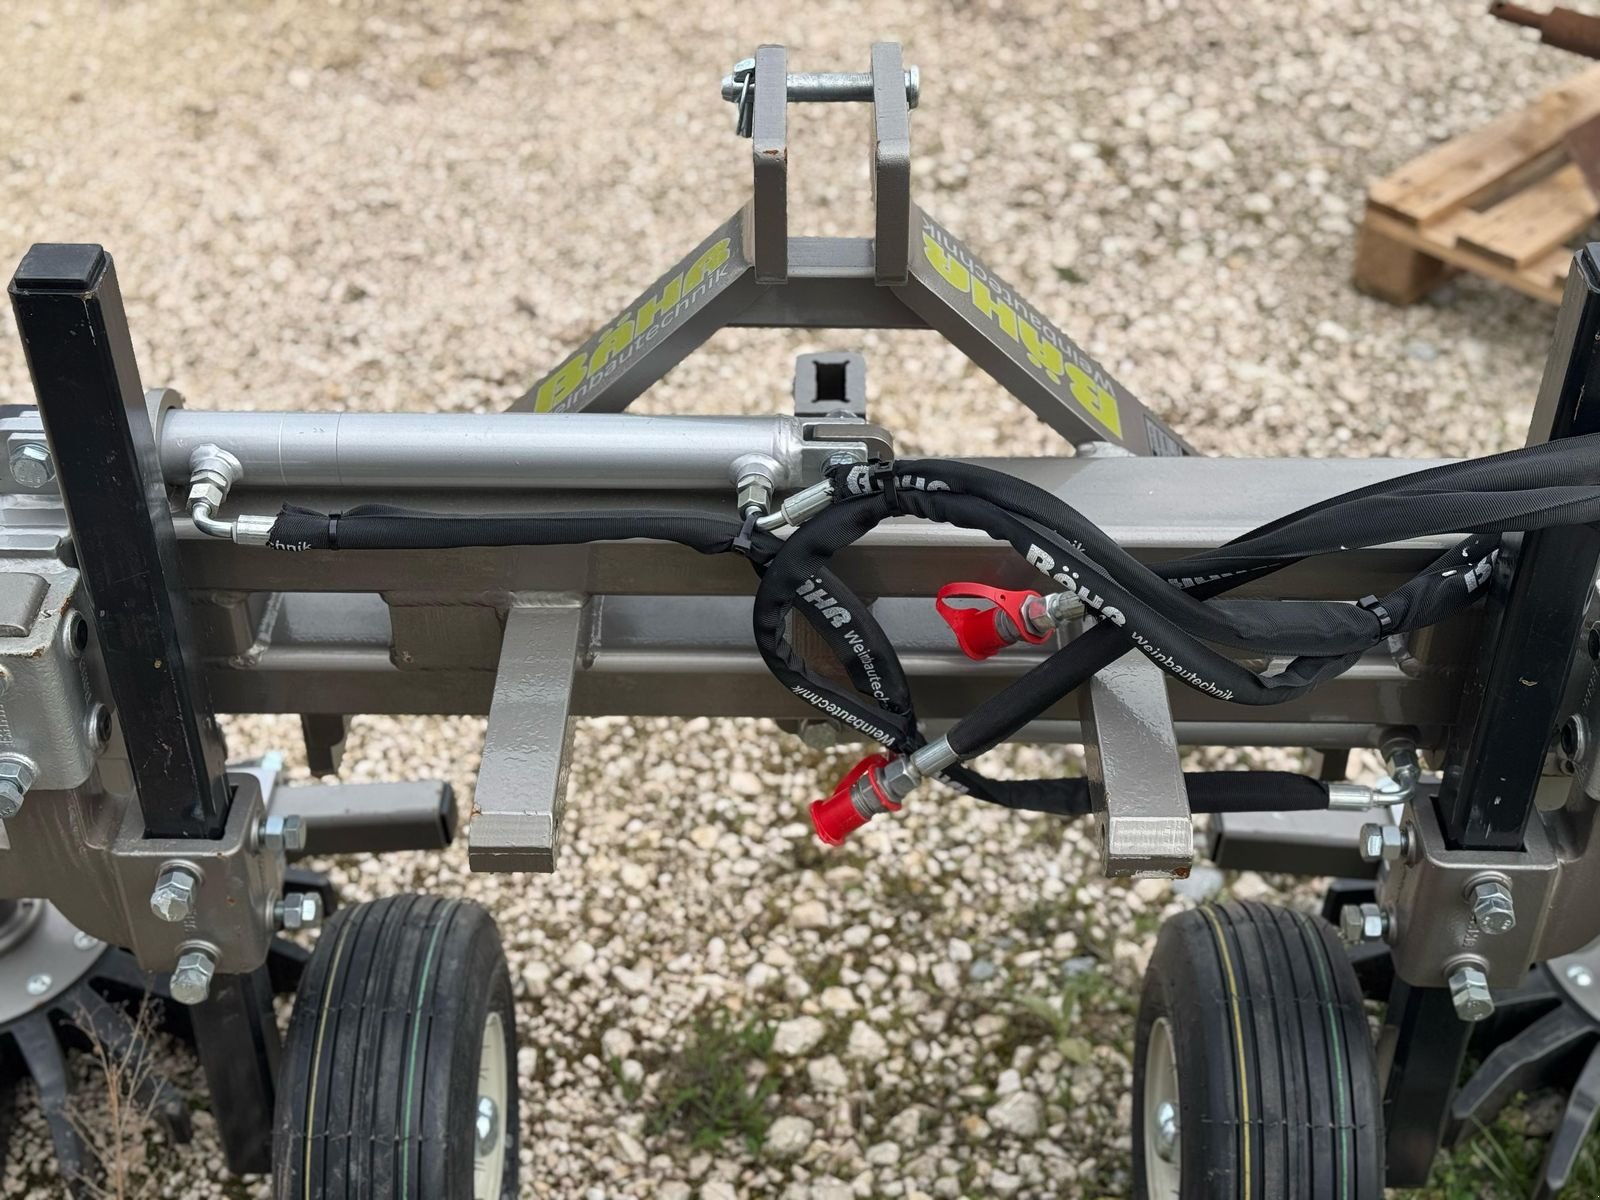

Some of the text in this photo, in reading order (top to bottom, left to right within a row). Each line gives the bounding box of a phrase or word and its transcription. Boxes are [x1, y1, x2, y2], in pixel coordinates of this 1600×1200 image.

[554, 264, 729, 413] einbautechnik
[922, 216, 1116, 397] Weinbautechnik
[791, 683, 896, 748] Weinbautechnik
[1131, 630, 1235, 701] Weinbautechnik
